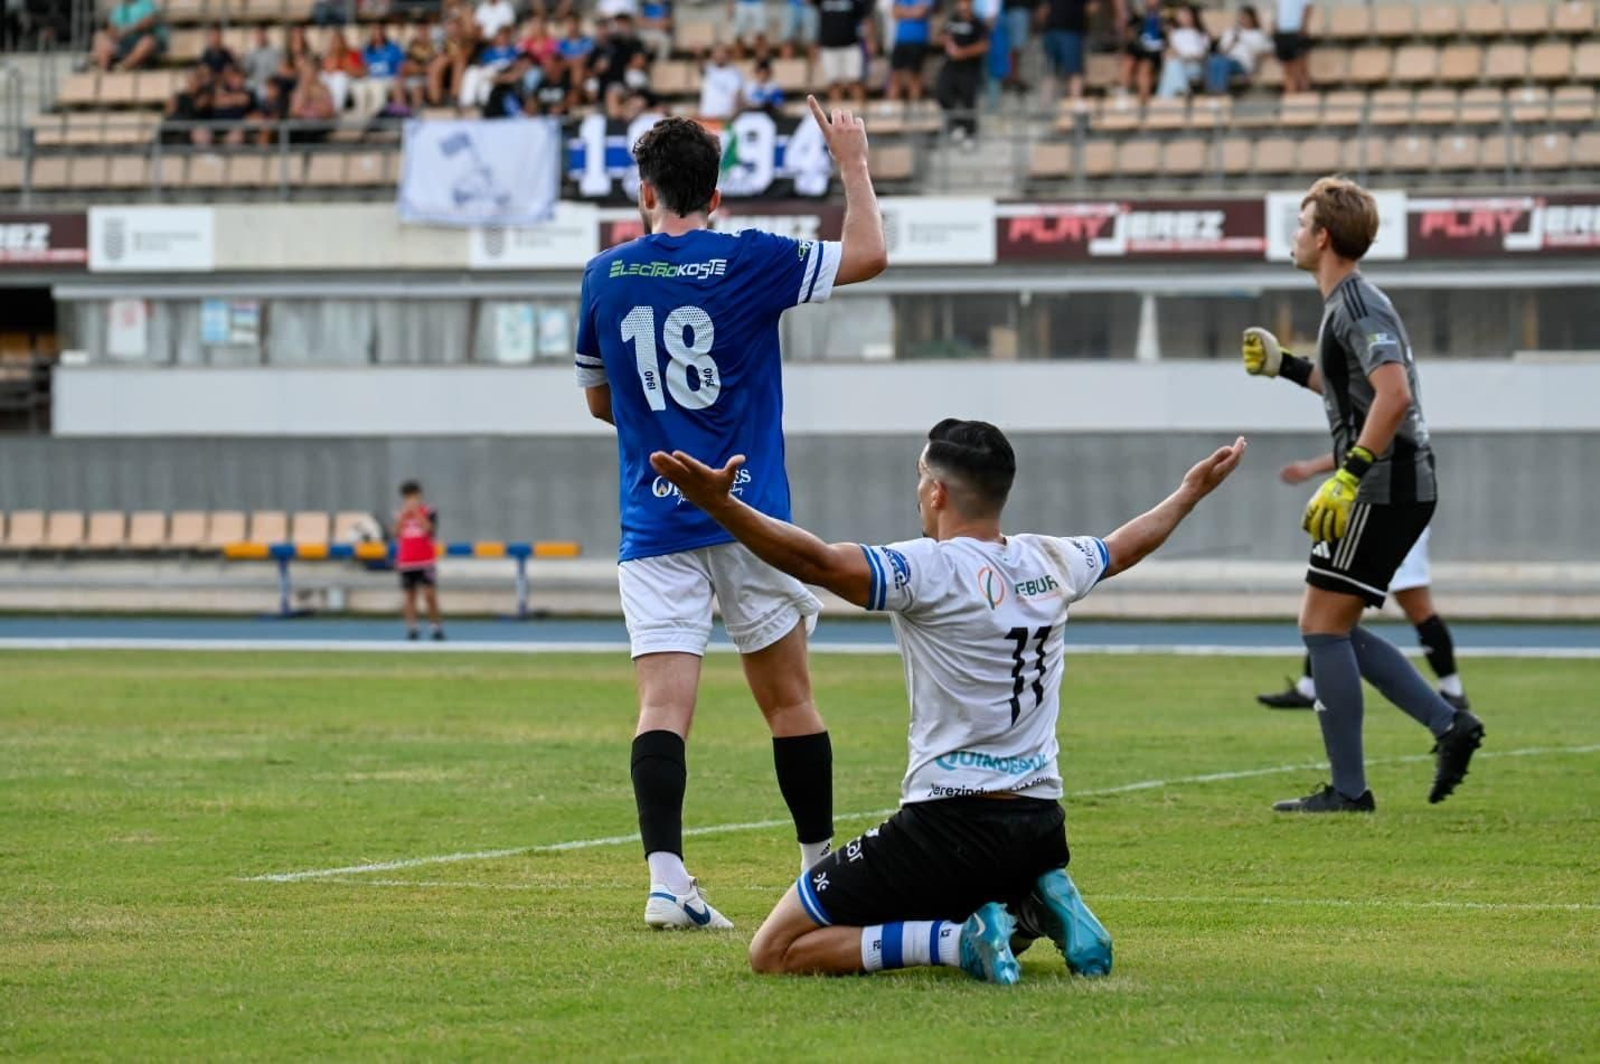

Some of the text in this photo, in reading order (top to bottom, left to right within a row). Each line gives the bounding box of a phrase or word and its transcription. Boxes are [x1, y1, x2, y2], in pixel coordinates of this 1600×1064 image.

[1089, 208, 1224, 255] JEREZ
[620, 305, 722, 412] 18
[644, 370, 657, 390] 1940
[1004, 625, 1052, 727] 11
